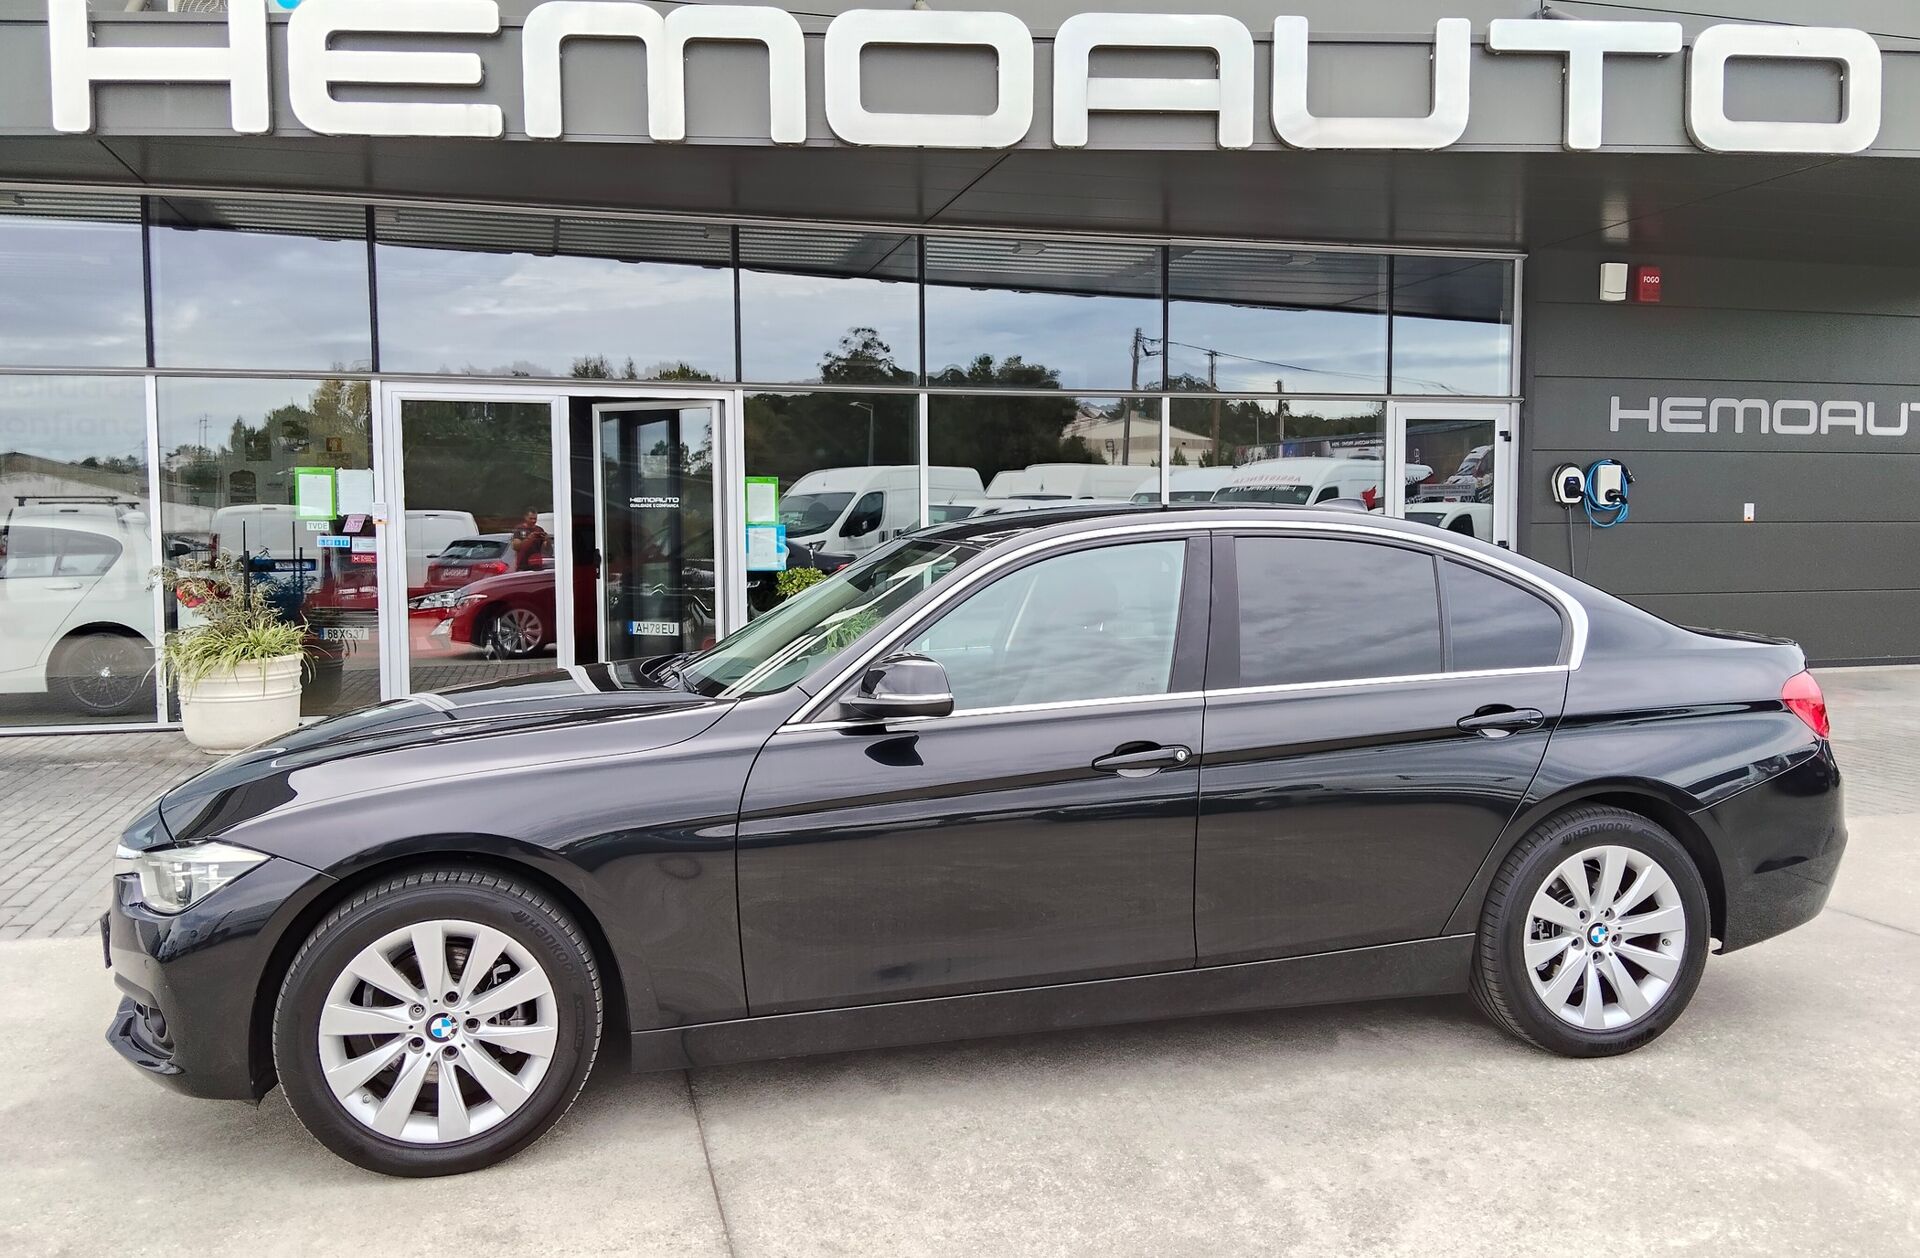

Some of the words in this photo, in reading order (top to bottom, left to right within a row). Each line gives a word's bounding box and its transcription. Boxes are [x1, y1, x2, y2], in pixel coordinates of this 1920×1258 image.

[49, 0, 1882, 155] HEMOAUTO
[1643, 275, 1660, 284] FOGO
[308, 522, 328, 530] TVDE
[636, 622, 675, 634] AH78EU
